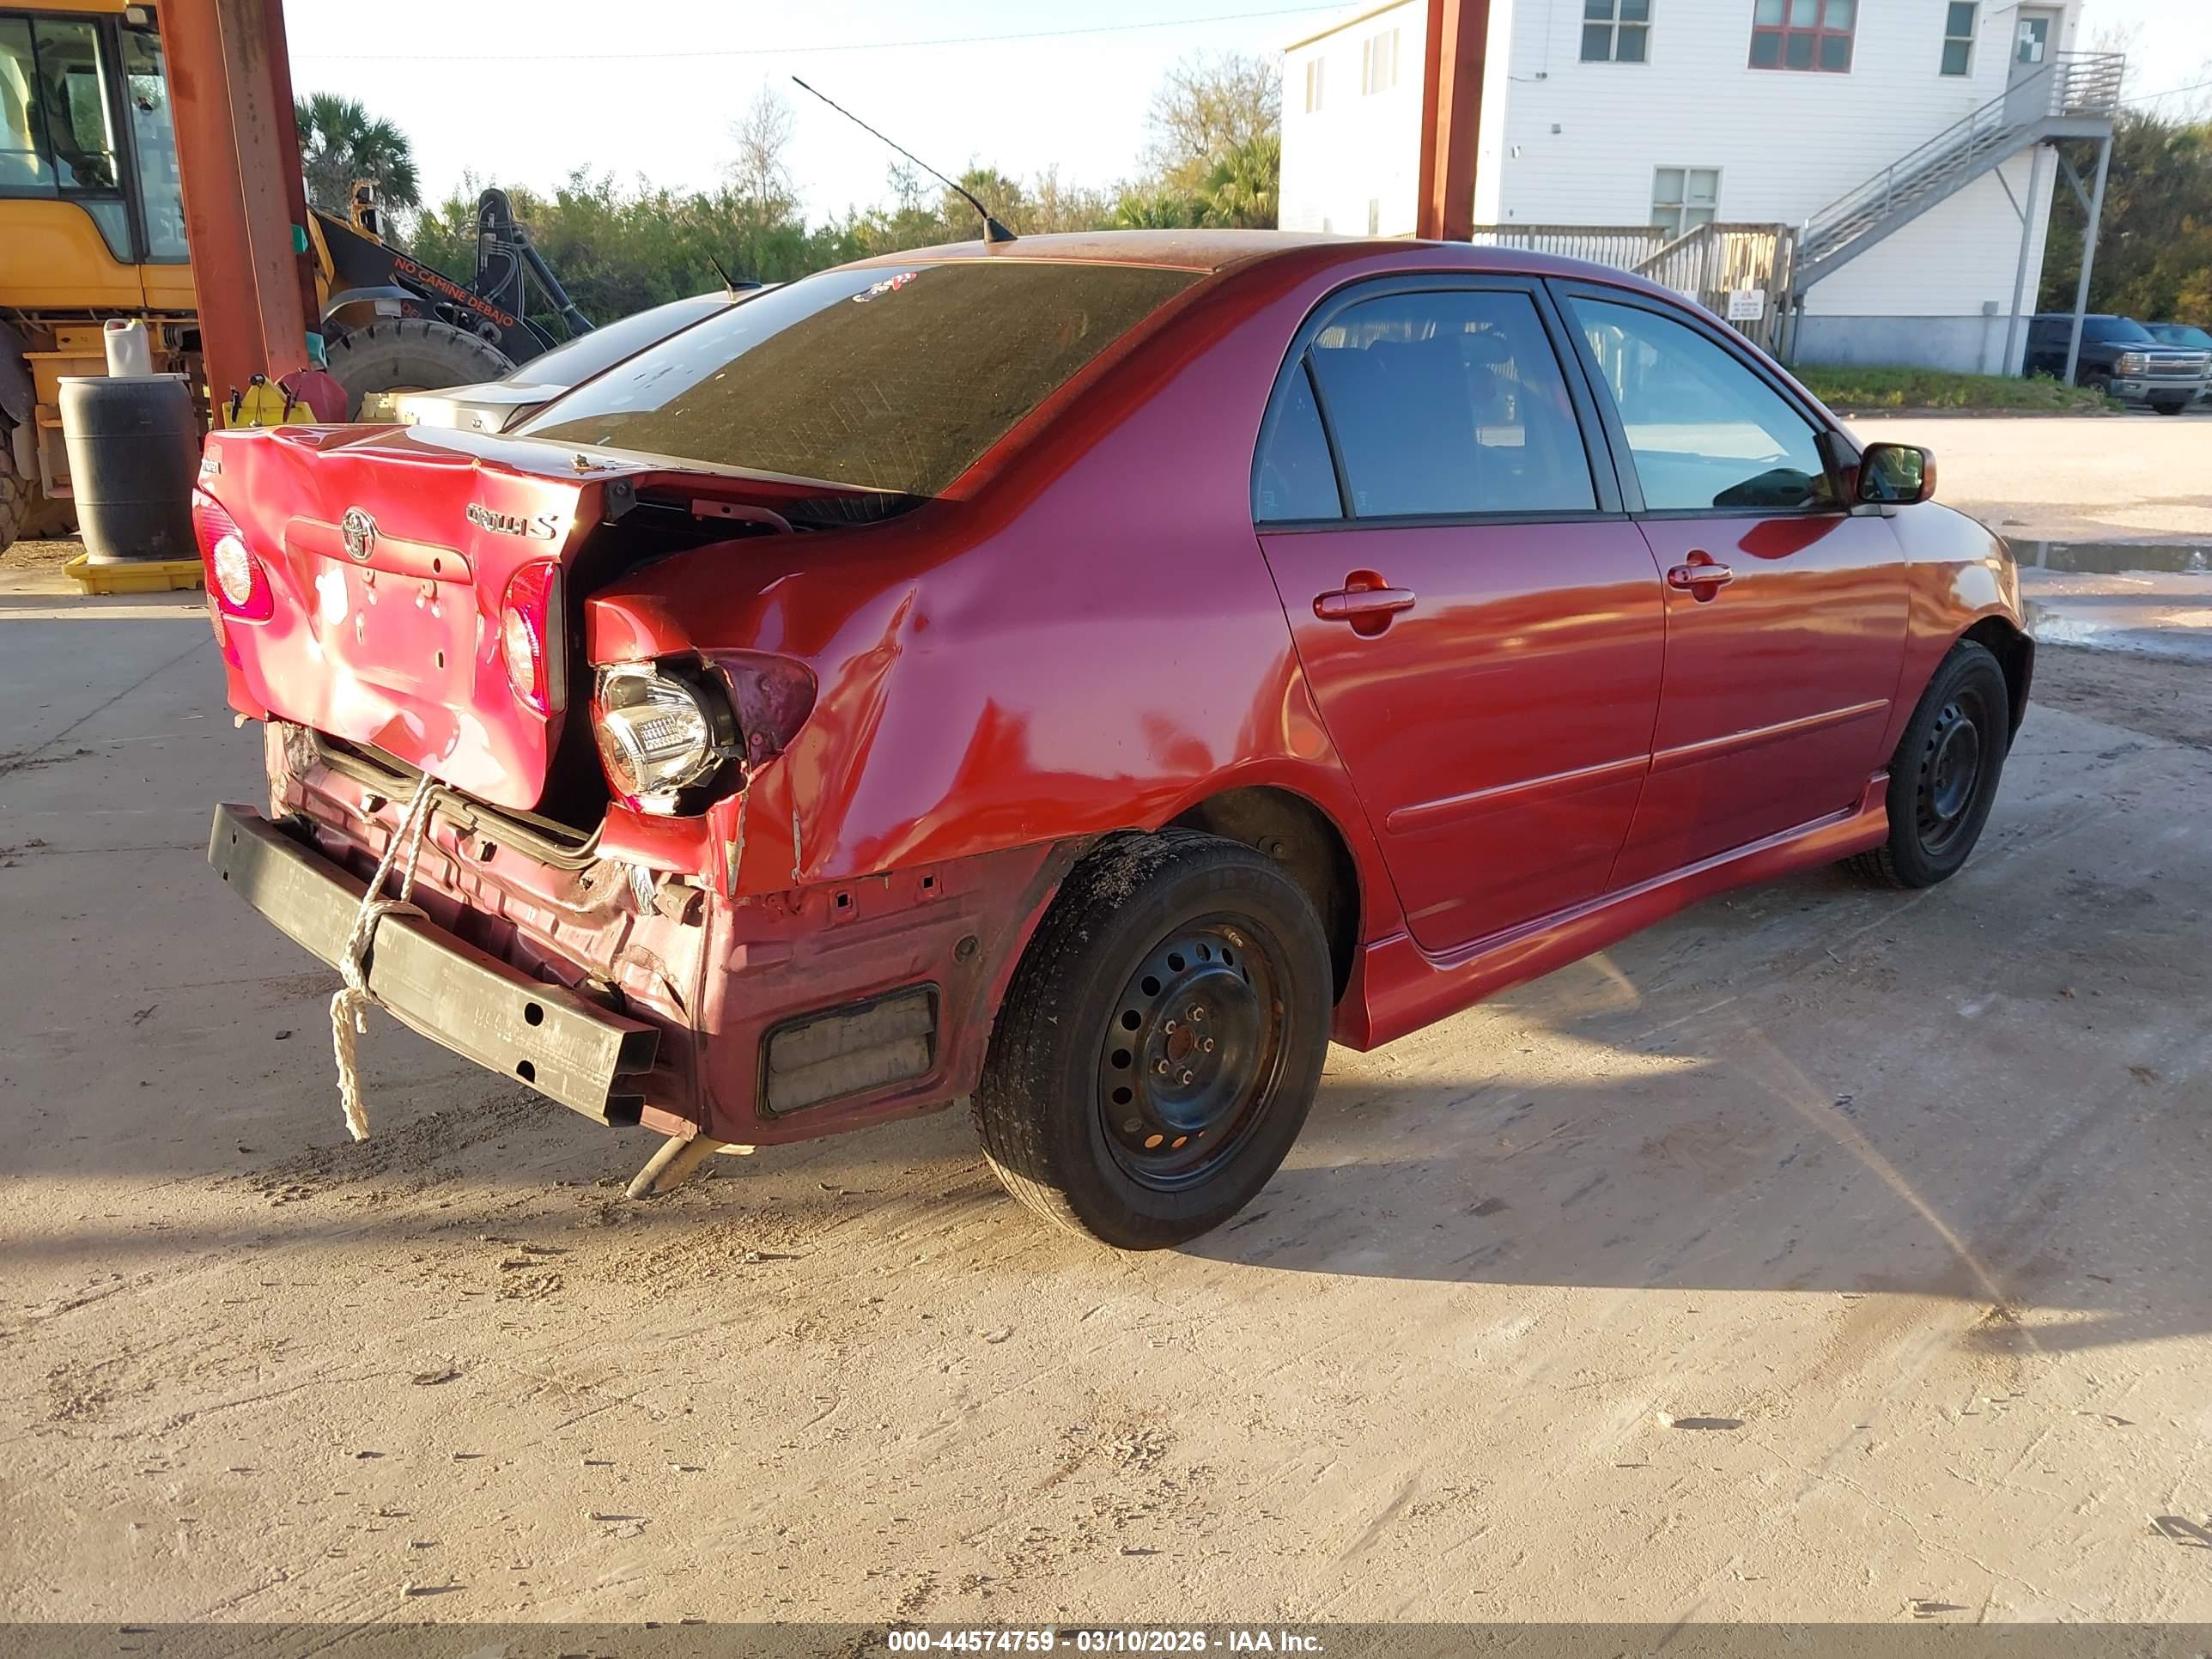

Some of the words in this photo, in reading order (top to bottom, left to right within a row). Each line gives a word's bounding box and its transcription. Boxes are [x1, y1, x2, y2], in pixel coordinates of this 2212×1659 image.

[395, 258, 416, 274] NO
[418, 270, 466, 302] CAMINE
[467, 296, 514, 327] DEBAJO
